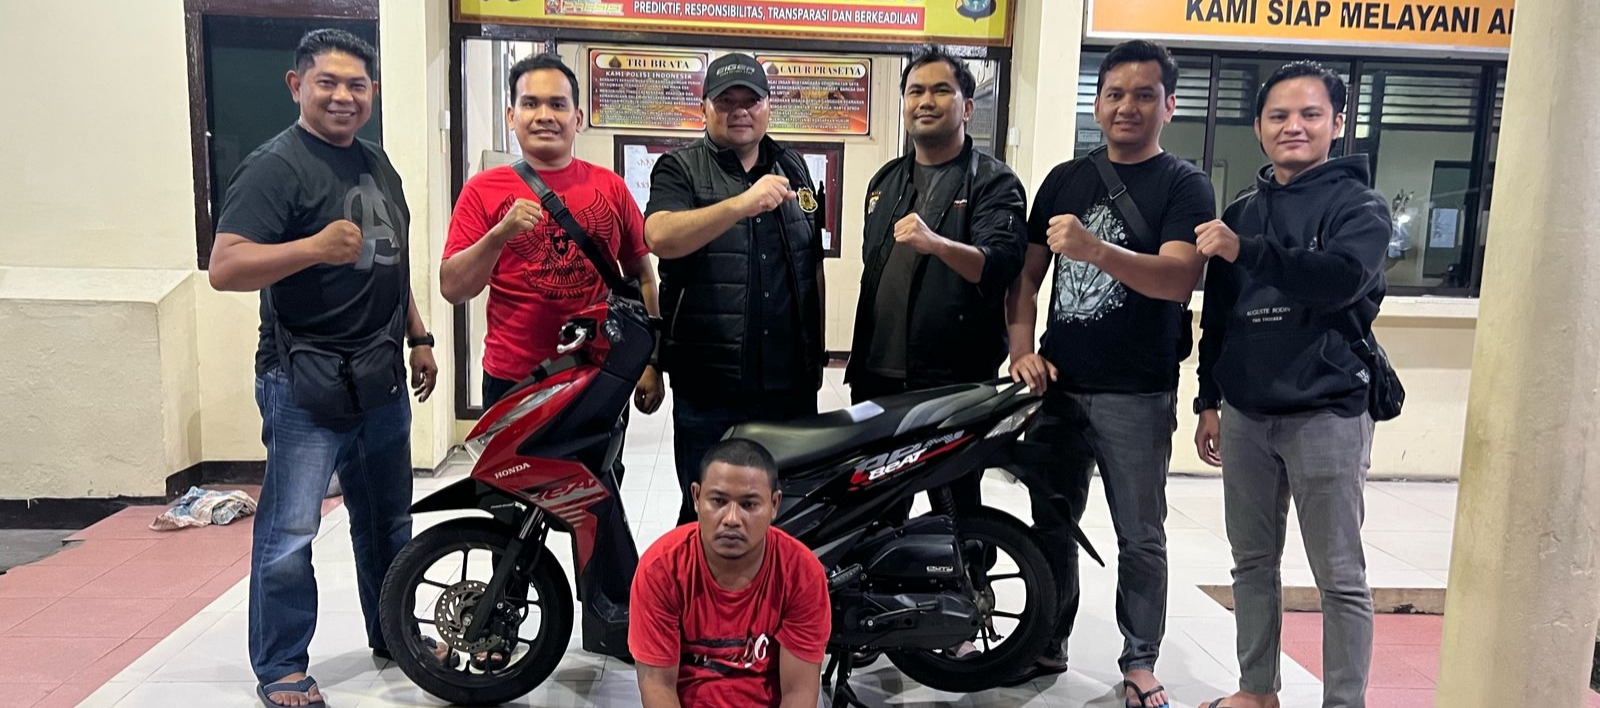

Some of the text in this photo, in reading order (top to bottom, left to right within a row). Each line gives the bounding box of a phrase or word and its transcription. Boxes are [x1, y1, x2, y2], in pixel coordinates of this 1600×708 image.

[633, 1, 918, 25] PREDIKTIF, RESPONSIBILITAS, TRANSPARASI DAN BERKEADILAN
[1185, 0, 1257, 24] KAMI
[1267, 0, 1331, 27] SIAP
[1340, 2, 1480, 33] MELAYANI
[626, 58, 690, 69] TRI BRATA
[780, 65, 862, 76] CATUR PRASETYA
[1246, 307, 1270, 316] AUGUSTE
[494, 462, 531, 480] HONDA
